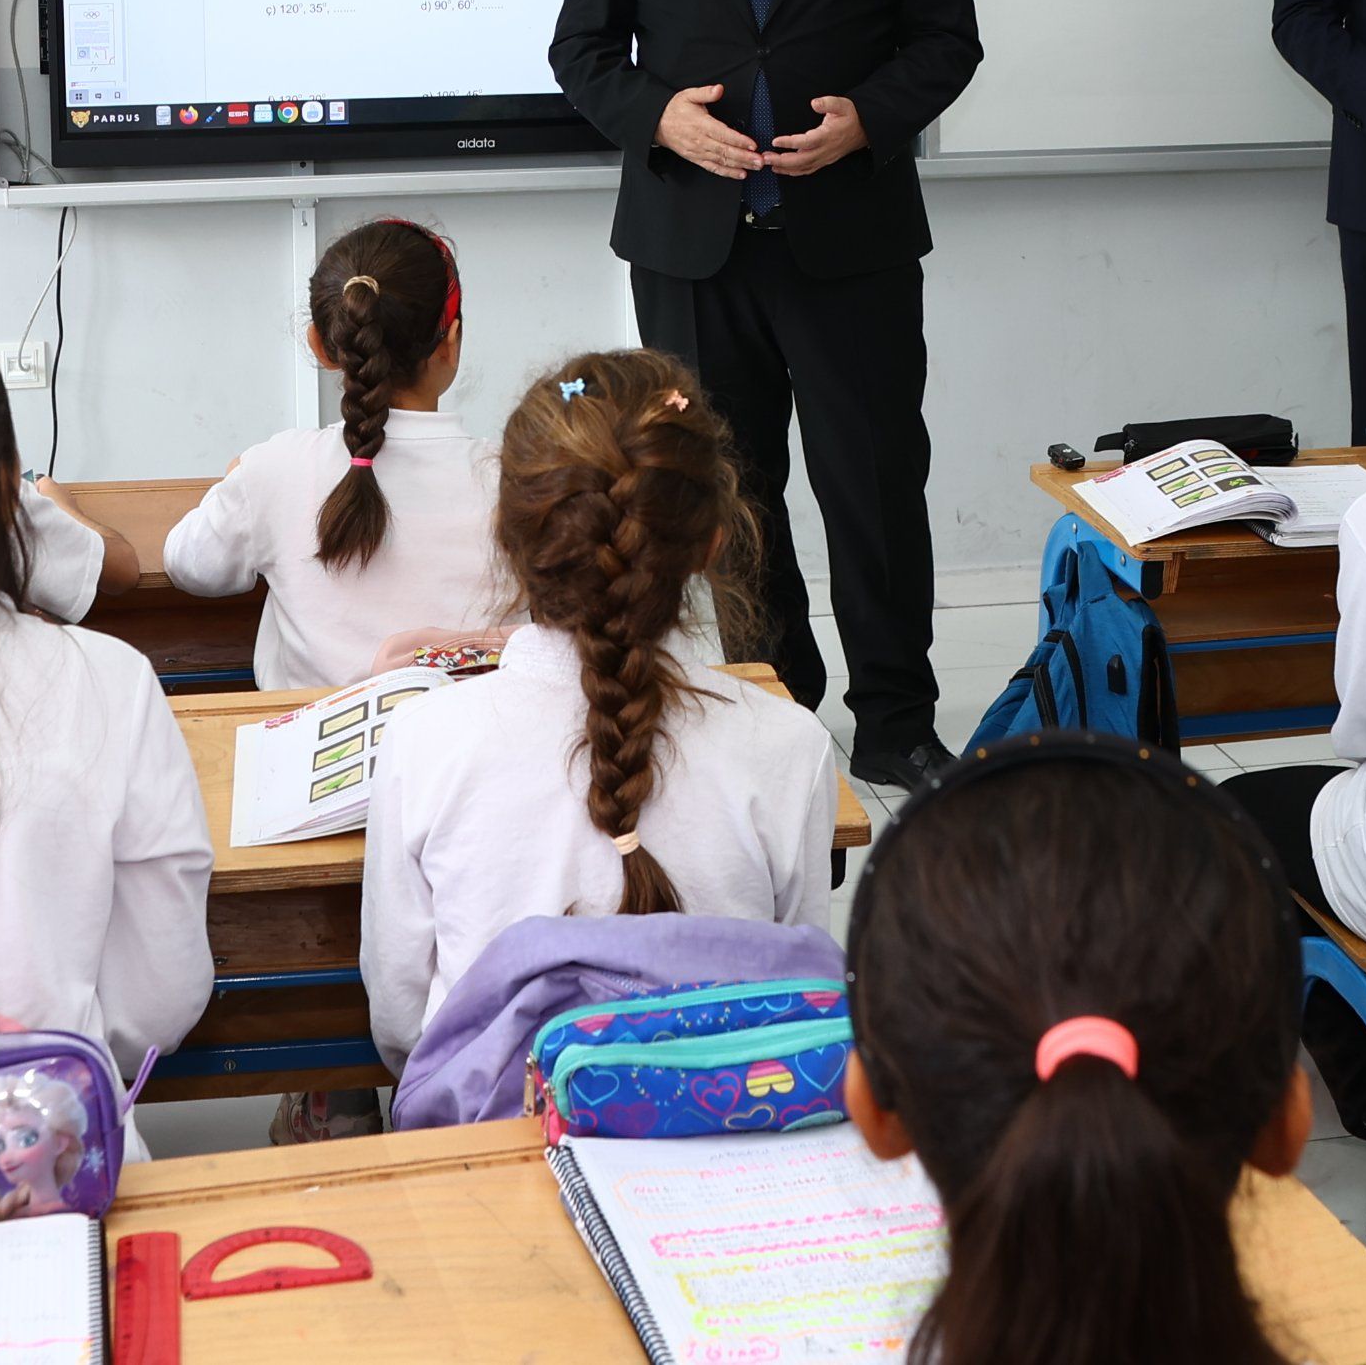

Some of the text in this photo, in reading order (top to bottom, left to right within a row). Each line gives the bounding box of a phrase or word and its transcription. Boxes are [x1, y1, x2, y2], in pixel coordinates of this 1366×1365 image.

[265, 5, 277, 16] ç)
[420, 1, 432, 12] d)
[93, 113, 140, 123] PARDUS
